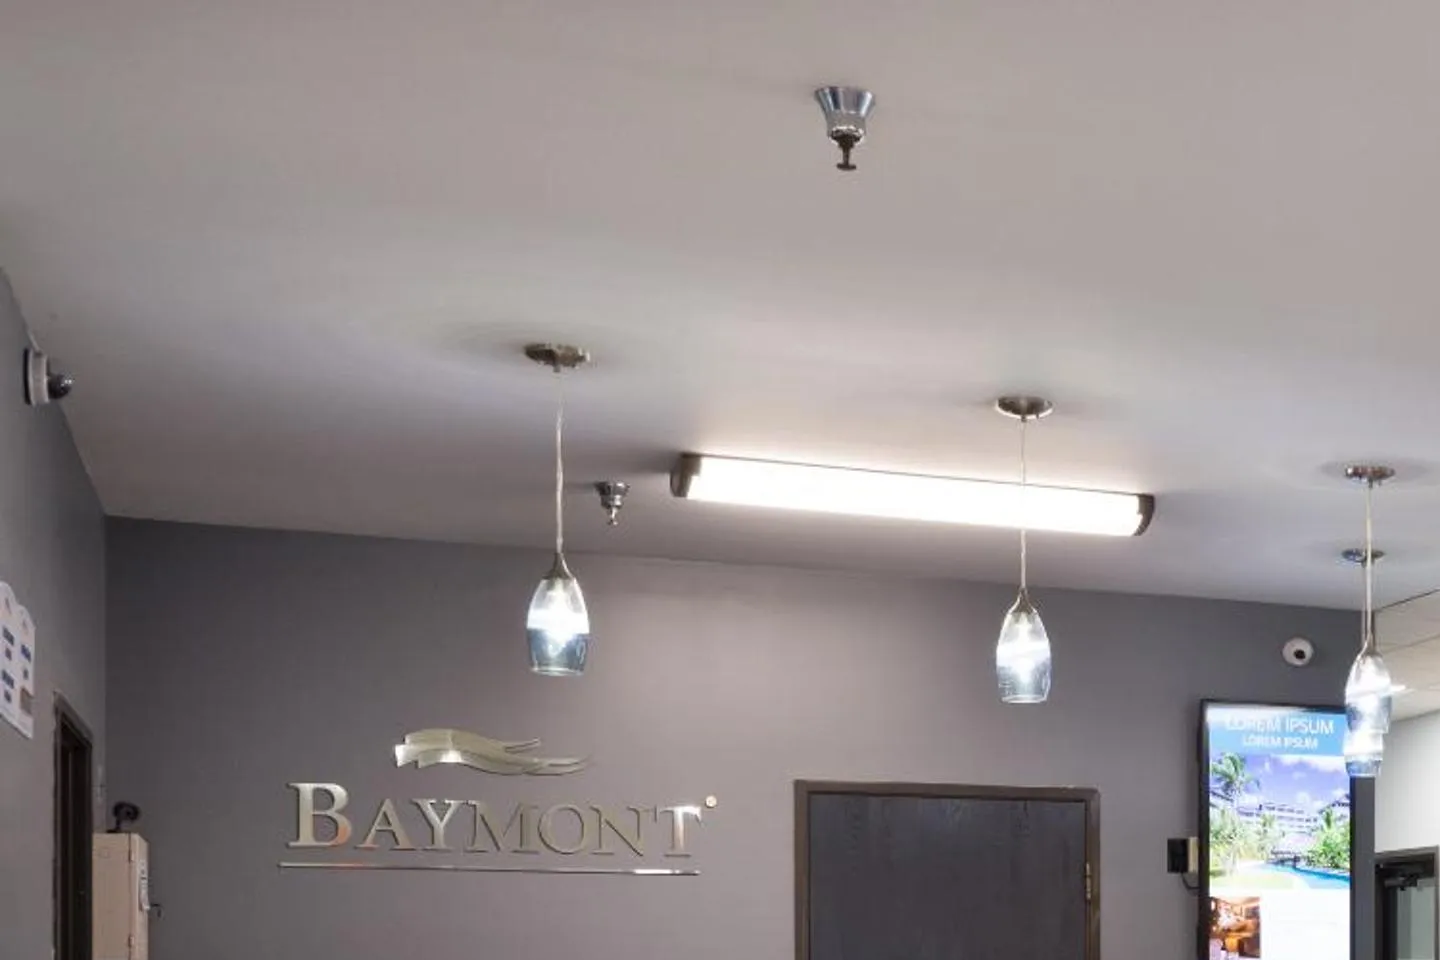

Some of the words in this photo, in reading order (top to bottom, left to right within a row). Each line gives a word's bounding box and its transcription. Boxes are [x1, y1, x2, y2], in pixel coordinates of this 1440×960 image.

[1226, 715, 1281, 733] LOREM
[1286, 717, 1335, 735] IPSUM
[286, 781, 702, 857] BAYMONT
